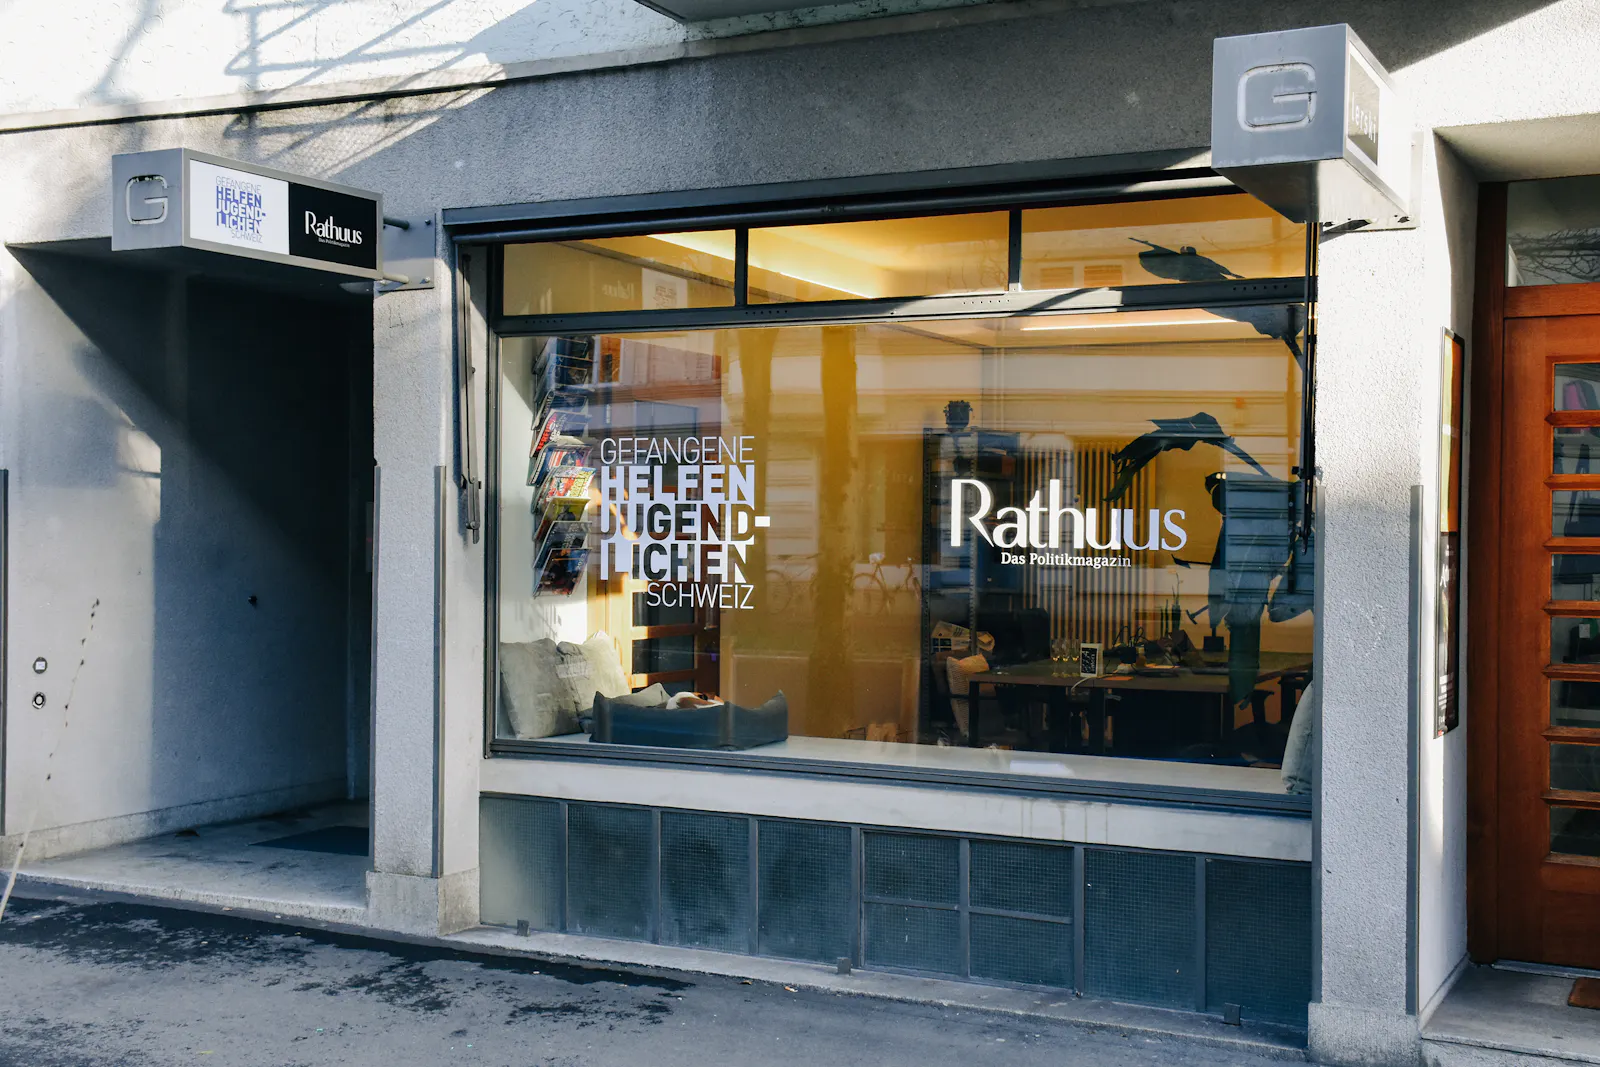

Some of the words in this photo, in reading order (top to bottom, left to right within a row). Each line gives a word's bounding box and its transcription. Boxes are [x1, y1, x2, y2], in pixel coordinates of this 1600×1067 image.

[216, 175, 262, 193] GEFANGENE
[216, 185, 262, 208] HELFEN
[216, 198, 266, 220] JUGEND-
[216, 211, 262, 234] LICHEN
[231, 229, 263, 243] SCHWEIZ
[305, 210, 363, 245] Rathuus
[600, 435, 755, 465] GEFANGENE
[600, 464, 755, 503] HELFEN
[600, 501, 771, 543] JUGEND-
[949, 478, 1188, 551] Rathuus
[601, 541, 755, 583] LICHEN
[1000, 551, 1026, 565] Das
[1029, 552, 1132, 570] Politikmagazin
[646, 582, 755, 609] SCHWEIZ
